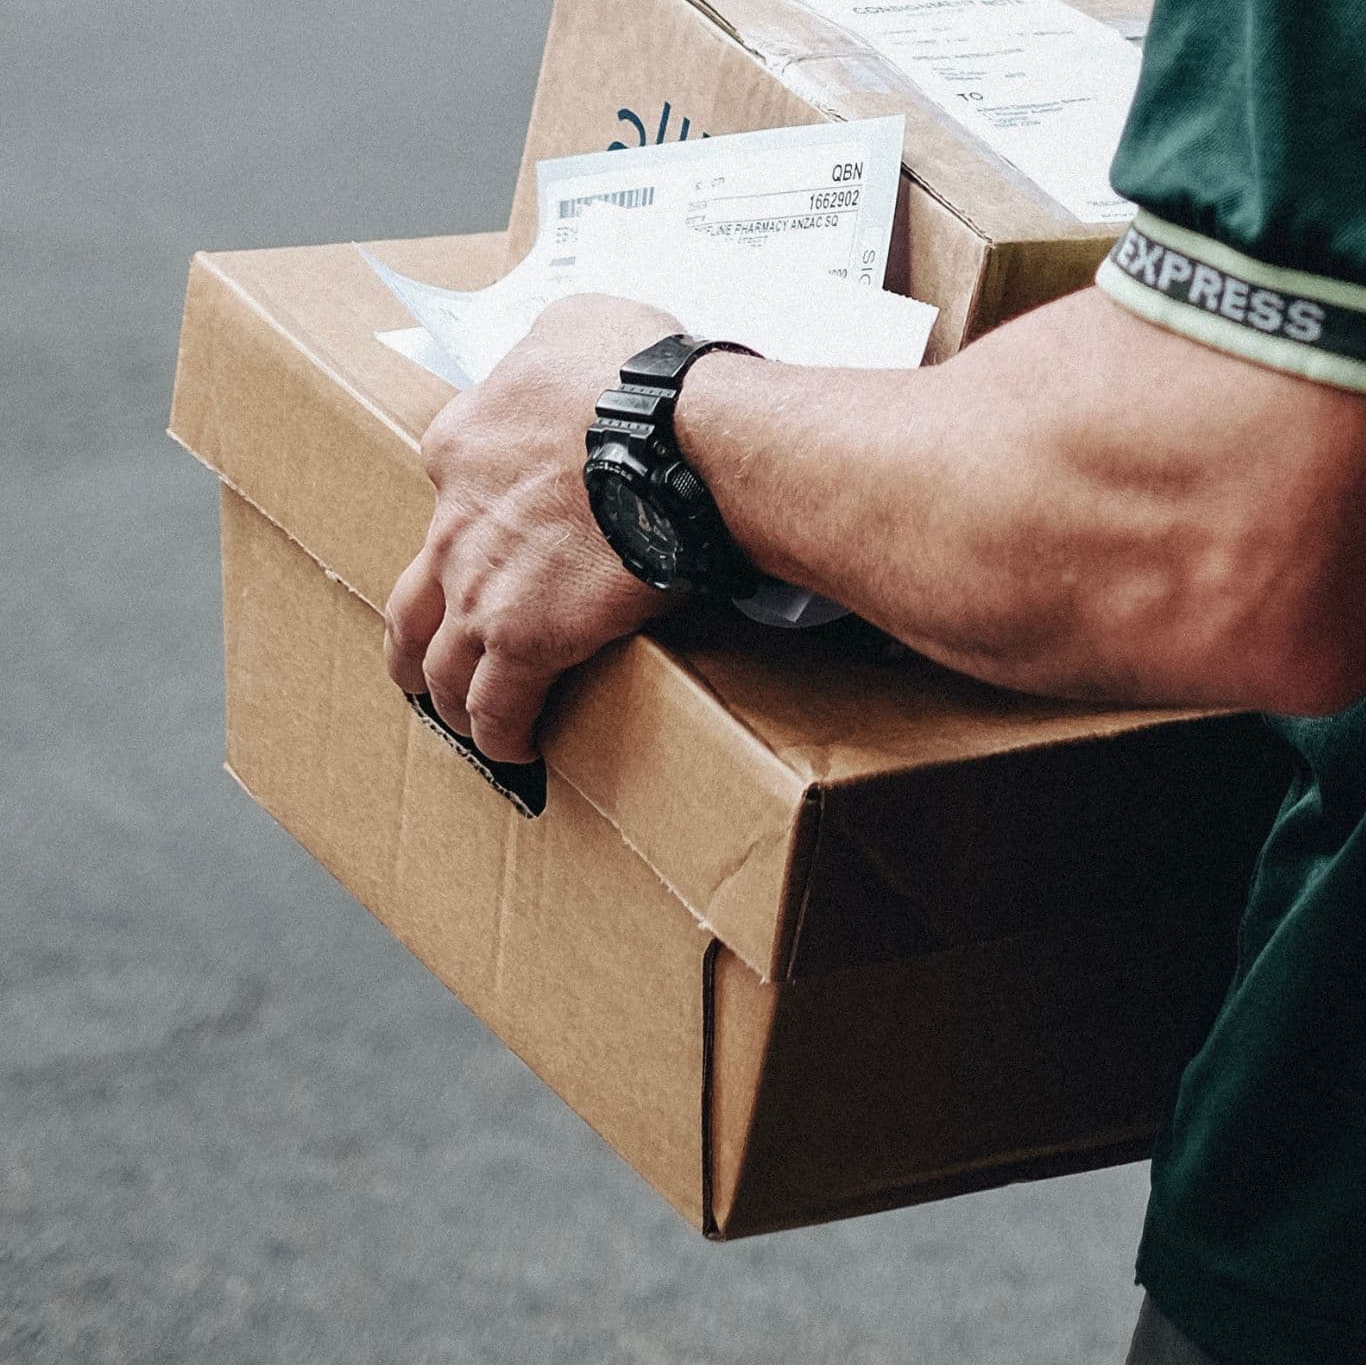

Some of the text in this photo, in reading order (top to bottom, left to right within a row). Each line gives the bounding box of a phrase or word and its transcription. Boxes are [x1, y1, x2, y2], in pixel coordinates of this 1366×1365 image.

[852, 0, 975, 16] CONSIGNMENT
[956, 91, 984, 102] TO
[832, 162, 864, 183] QBN
[809, 189, 860, 211] 1662902
[734, 219, 788, 236] PHARMACY
[790, 215, 823, 230] ANZAC
[825, 213, 840, 228] SQ
[1115, 230, 1326, 344] EXPRESS
